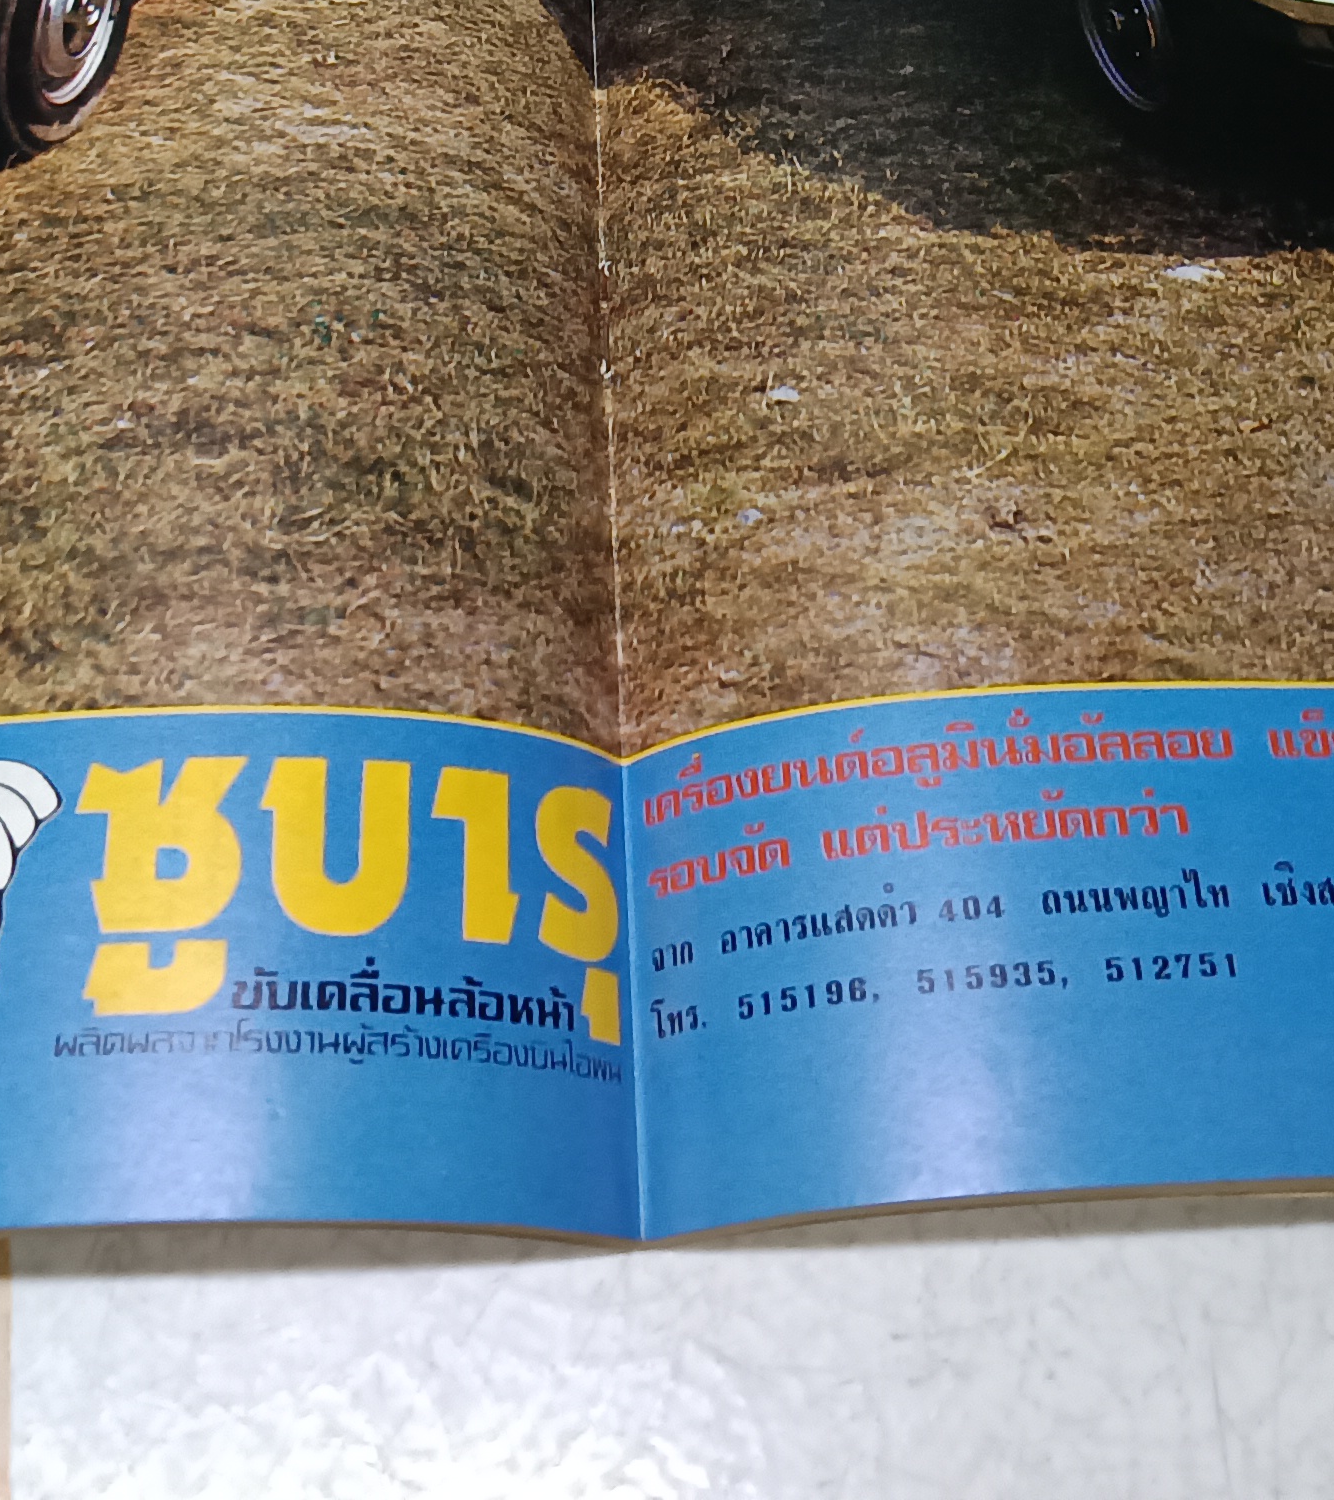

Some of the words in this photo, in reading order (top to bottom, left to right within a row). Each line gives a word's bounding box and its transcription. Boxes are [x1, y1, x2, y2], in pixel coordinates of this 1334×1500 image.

[647, 821, 791, 899] รอบจัด
[821, 788, 1190, 861] แต่ประหยัดกว่า
[75, 754, 622, 1046] ซูบารุ
[938, 894, 1006, 923] 404
[1040, 867, 1231, 919] ถนนพญาไท
[231, 956, 576, 1032] ขับเคลื่อนล้อหน้า
[649, 998, 708, 1040] โทร.
[738, 976, 880, 1021] 515196,
[916, 959, 1068, 995] 515935,
[1104, 951, 1238, 983] 512751
